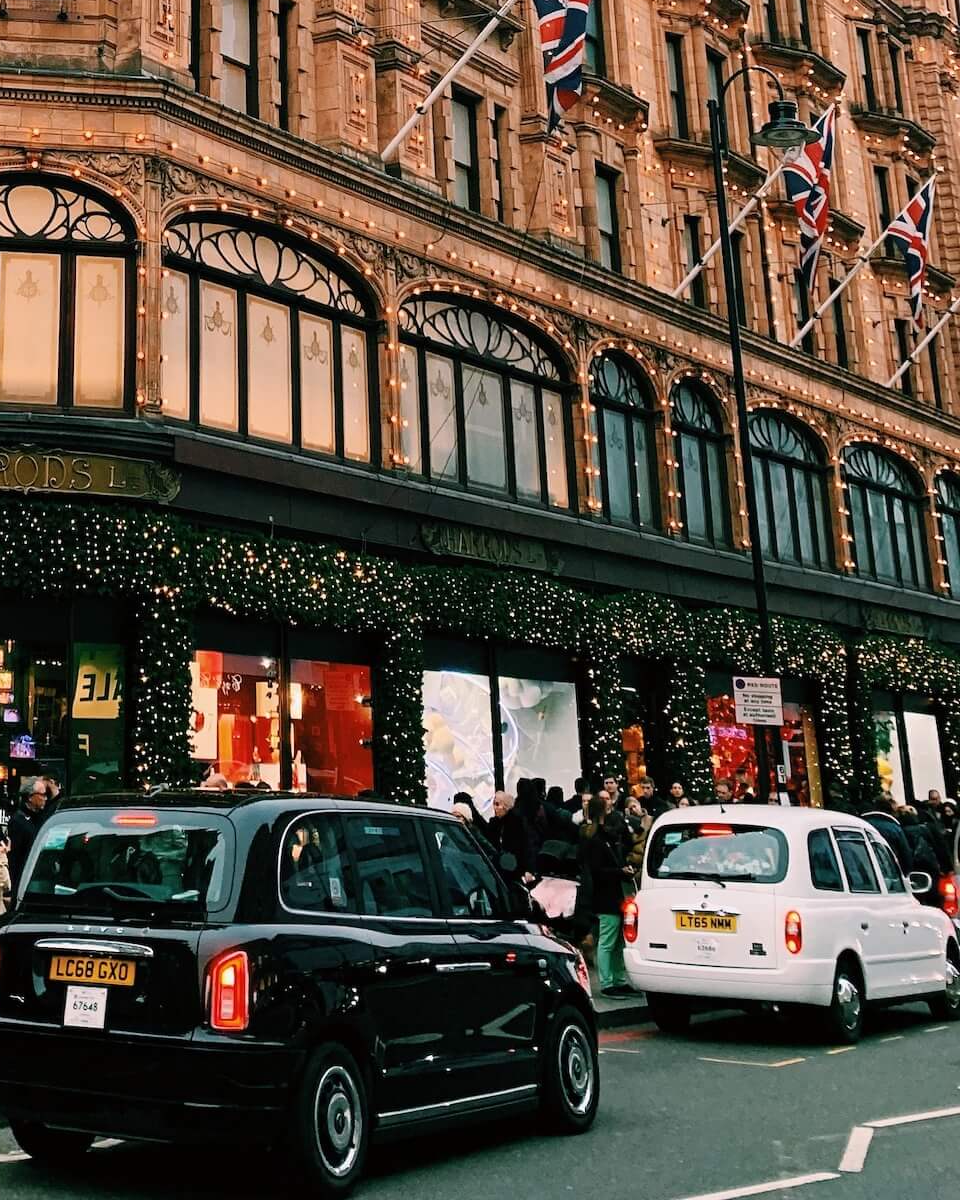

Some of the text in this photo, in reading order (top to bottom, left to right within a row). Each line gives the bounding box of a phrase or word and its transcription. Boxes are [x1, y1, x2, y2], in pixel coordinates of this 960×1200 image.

[680, 916, 732, 930] LT65 NMM
[56, 958, 129, 981] LC68 GXO
